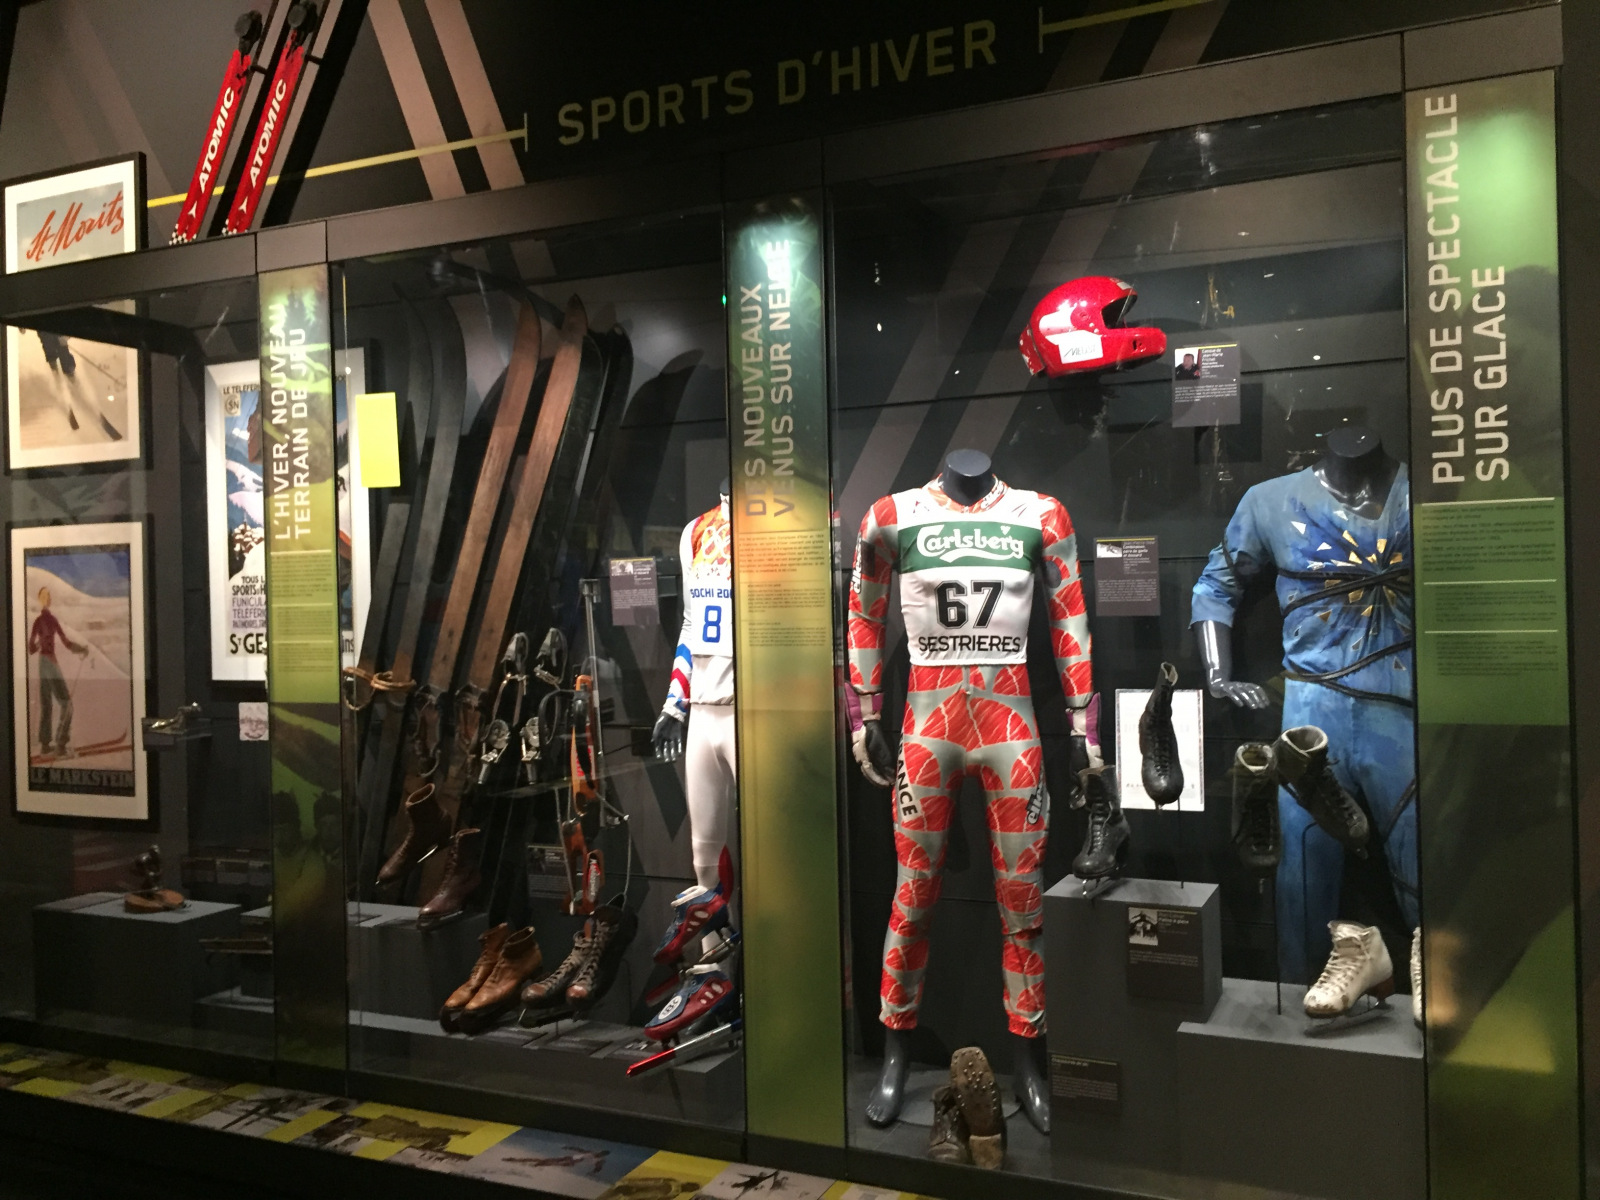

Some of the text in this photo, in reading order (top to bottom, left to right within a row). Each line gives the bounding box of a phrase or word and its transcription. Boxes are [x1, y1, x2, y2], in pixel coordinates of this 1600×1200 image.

[248, 78, 288, 187] ATOMIC
[557, 19, 998, 146] SPORTS D'HIVER
[198, 86, 236, 195] ATOMIC
[1424, 93, 1465, 484] PLUS DE SPECTACLE
[268, 303, 289, 425] NOUVEAU
[290, 387, 308, 419] DE
[740, 282, 767, 516] DES NOUVEAUX
[767, 239, 795, 517] VENUS SUR NEIGE
[1471, 265, 1510, 481] SUR GLACE
[291, 426, 311, 541] TERRAIN
[690, 587, 714, 599] SOCHI
[916, 524, 1024, 561] Carlsberg
[702, 604, 722, 643] 8
[917, 634, 1021, 653] SESTRIERES
[934, 579, 1005, 629] 67
